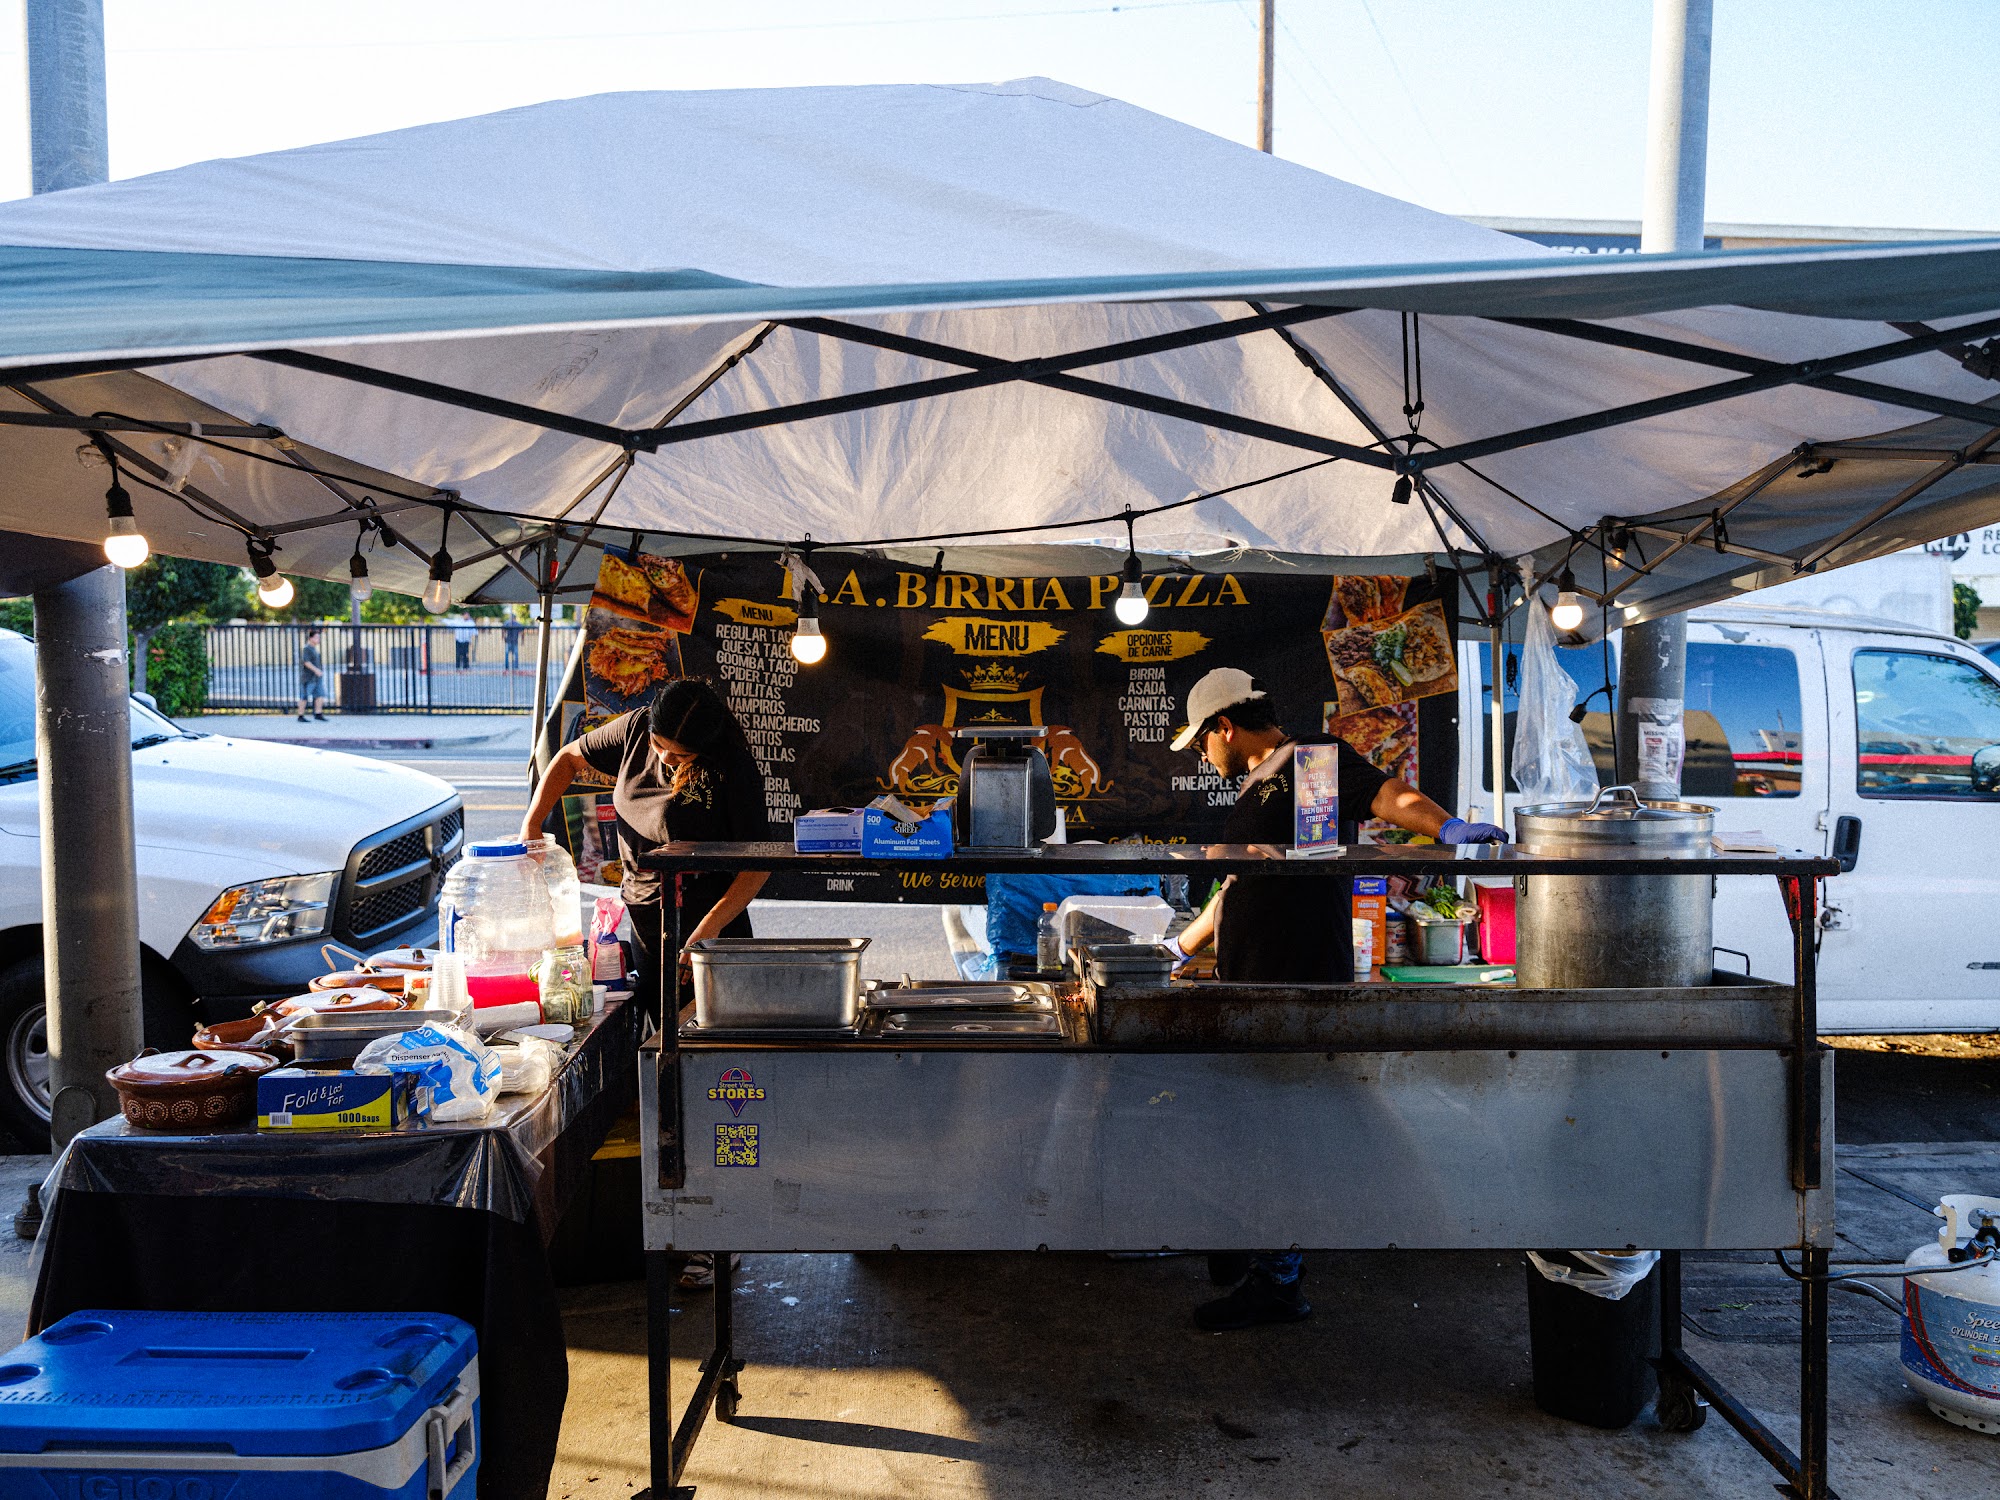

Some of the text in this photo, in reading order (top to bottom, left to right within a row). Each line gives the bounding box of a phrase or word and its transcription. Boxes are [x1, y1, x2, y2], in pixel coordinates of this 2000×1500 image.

[893, 571, 1074, 611] BIRRIA
[1087, 573, 1250, 609] PZZA
[742, 606, 773, 621] MENU
[716, 624, 767, 642] REGULAR
[965, 623, 1029, 651] MENU
[1127, 633, 1172, 647] OPCIONES
[722, 640, 794, 659] QUESA TACO
[1128, 645, 1173, 657] DE CARNE
[716, 650, 799, 675] GOOMBA TACO
[720, 665, 794, 688] SPIDER TACO
[1129, 667, 1166, 680] BIRRIA
[730, 681, 782, 700] MULITAS
[1128, 681, 1167, 695] ASADA
[726, 696, 786, 715] VAMPIROS
[1118, 696, 1176, 711] CARNITAS
[752, 714, 820, 733] RANCHEROS
[1124, 712, 1170, 727] PASTOR
[744, 729, 783, 747] RRITOS
[1129, 727, 1165, 742] POLLO
[751, 745, 796, 762] DILLLAS
[764, 777, 791, 792] IBRA
[1171, 775, 1233, 791] PINEAPPLE
[765, 793, 802, 809] BIRRIA
[867, 815, 881, 824] 500
[852, 827, 858, 835] L
[826, 878, 854, 892] DRINK
[391, 1053, 431, 1062] Dispenser
[282, 1087, 319, 1114] Fold
[320, 1086, 327, 1099] &
[708, 1088, 765, 1099] STORES
[337, 1112, 380, 1124] 1000 Bags
[1964, 1311, 2000, 1330] Spee
[1951, 1326, 1989, 1343] CYLINDER
